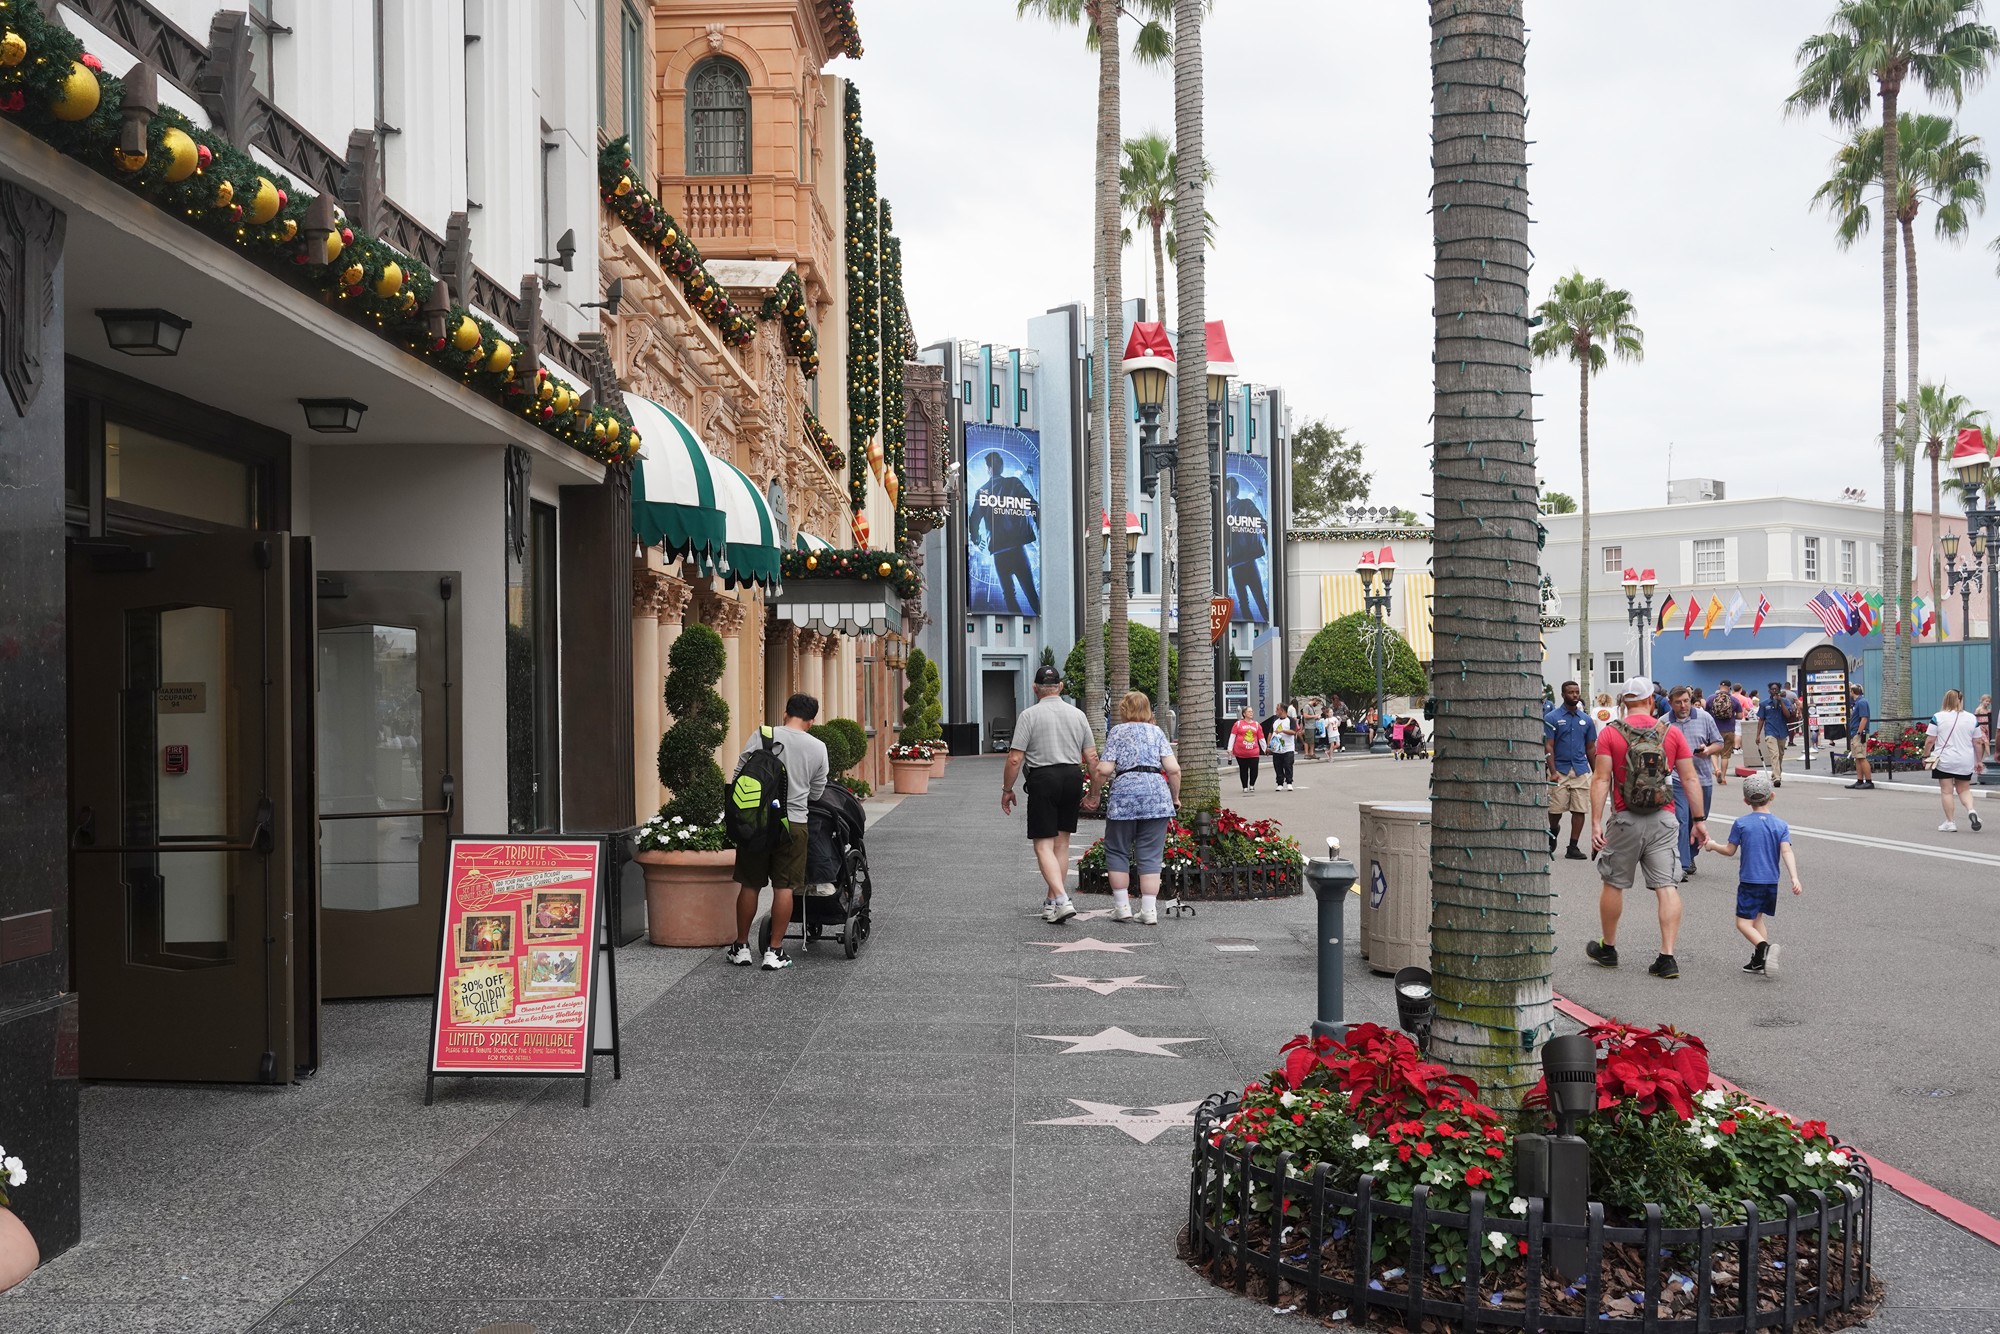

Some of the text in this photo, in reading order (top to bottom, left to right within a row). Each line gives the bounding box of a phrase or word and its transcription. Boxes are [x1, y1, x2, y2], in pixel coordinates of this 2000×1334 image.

[980, 495, 1031, 510] BOURNE
[994, 508, 1036, 517] STUNTACULAR
[1226, 514, 1262, 528] OURNE
[1232, 526, 1266, 534] STUNTACULAR
[1211, 604, 1227, 616] RLY
[505, 846, 546, 860] TRIBUTE
[461, 974, 504, 994] 30% OFF
[462, 985, 506, 1007] HOLIDAY
[474, 1000, 499, 1016] SALE!
[503, 1017, 524, 1025] Create
[530, 1014, 554, 1022] lasting
[555, 1010, 583, 1018] Holiday
[556, 1016, 582, 1024] memory
[449, 1032, 574, 1048] LIMITED SPACE AVAILABLE
